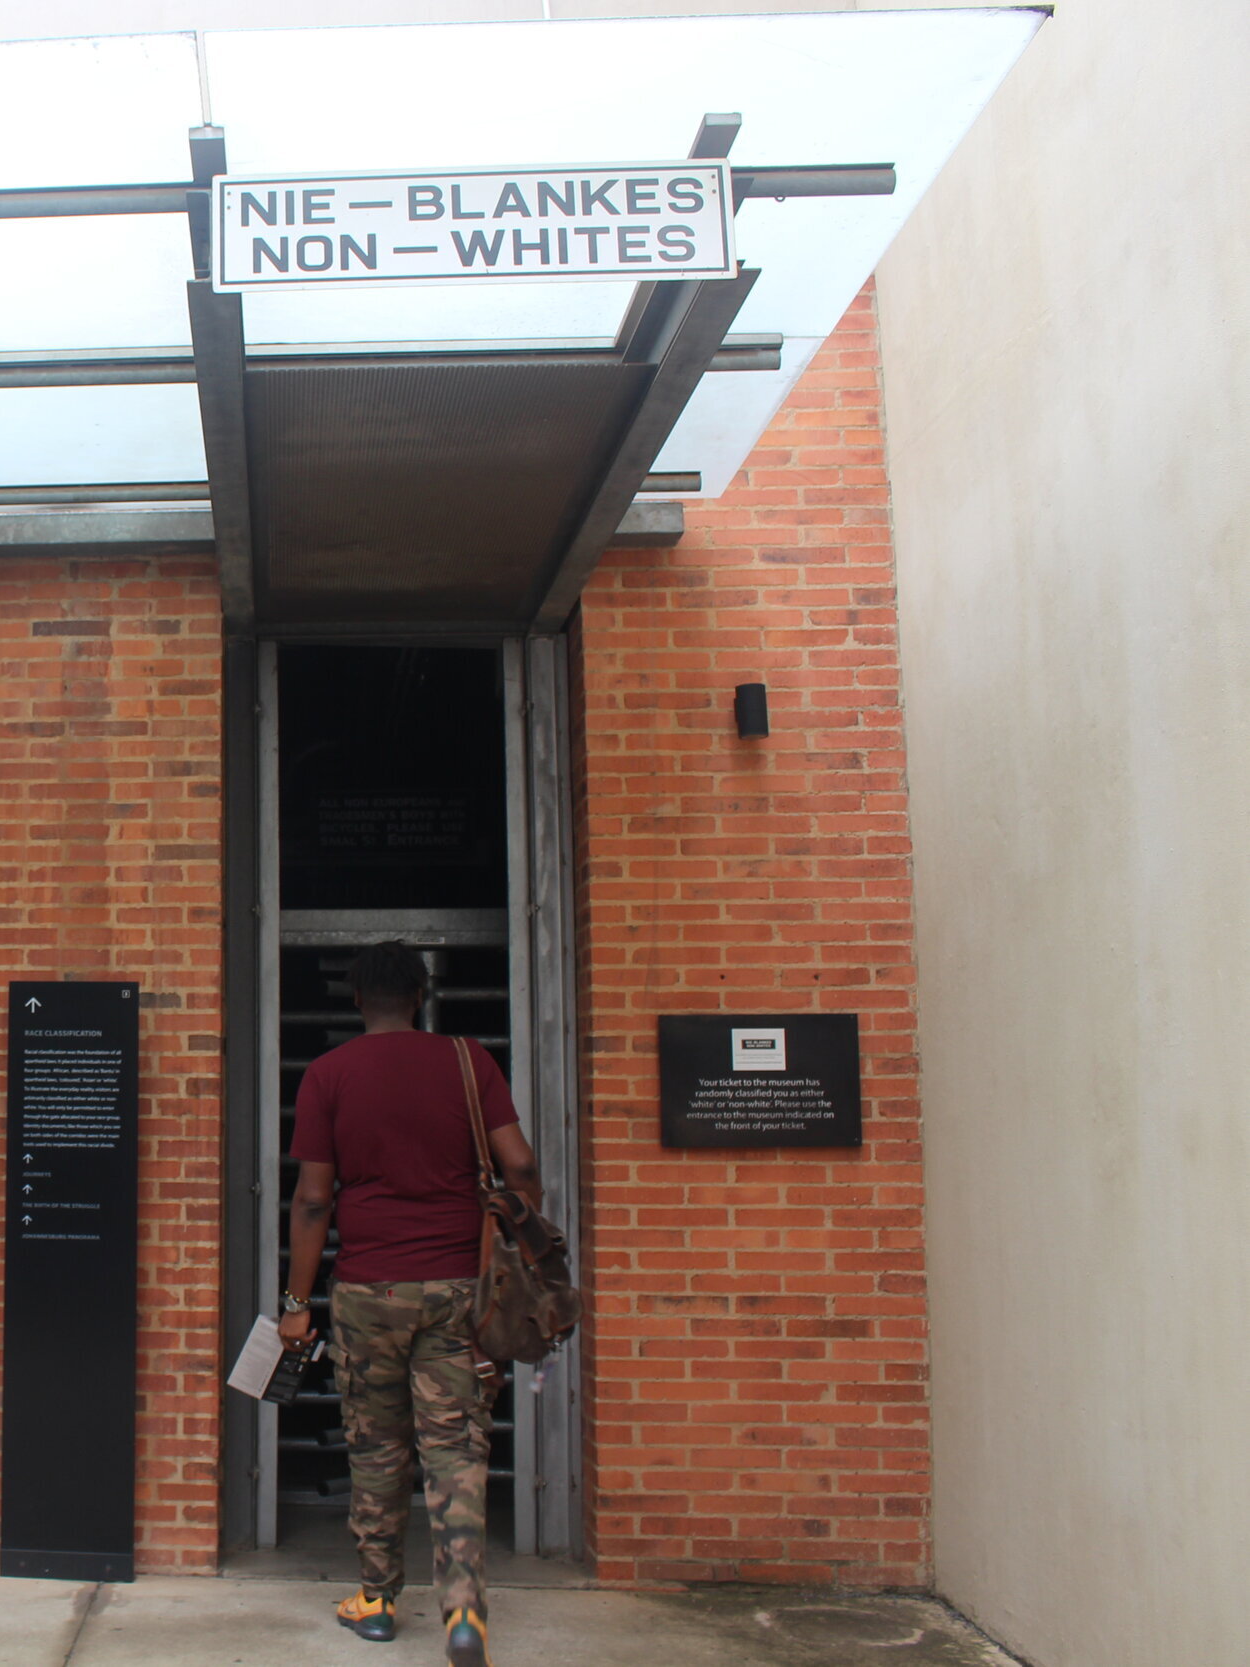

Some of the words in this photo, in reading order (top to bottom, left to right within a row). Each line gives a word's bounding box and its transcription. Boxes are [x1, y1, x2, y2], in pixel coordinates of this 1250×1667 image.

[805, 1078, 820, 1086] has
[695, 1090, 734, 1098] randomly
[735, 1089, 772, 1097] classified
[715, 1122, 729, 1130] the
[752, 1121, 761, 1129] of
[761, 1123, 781, 1131] your
